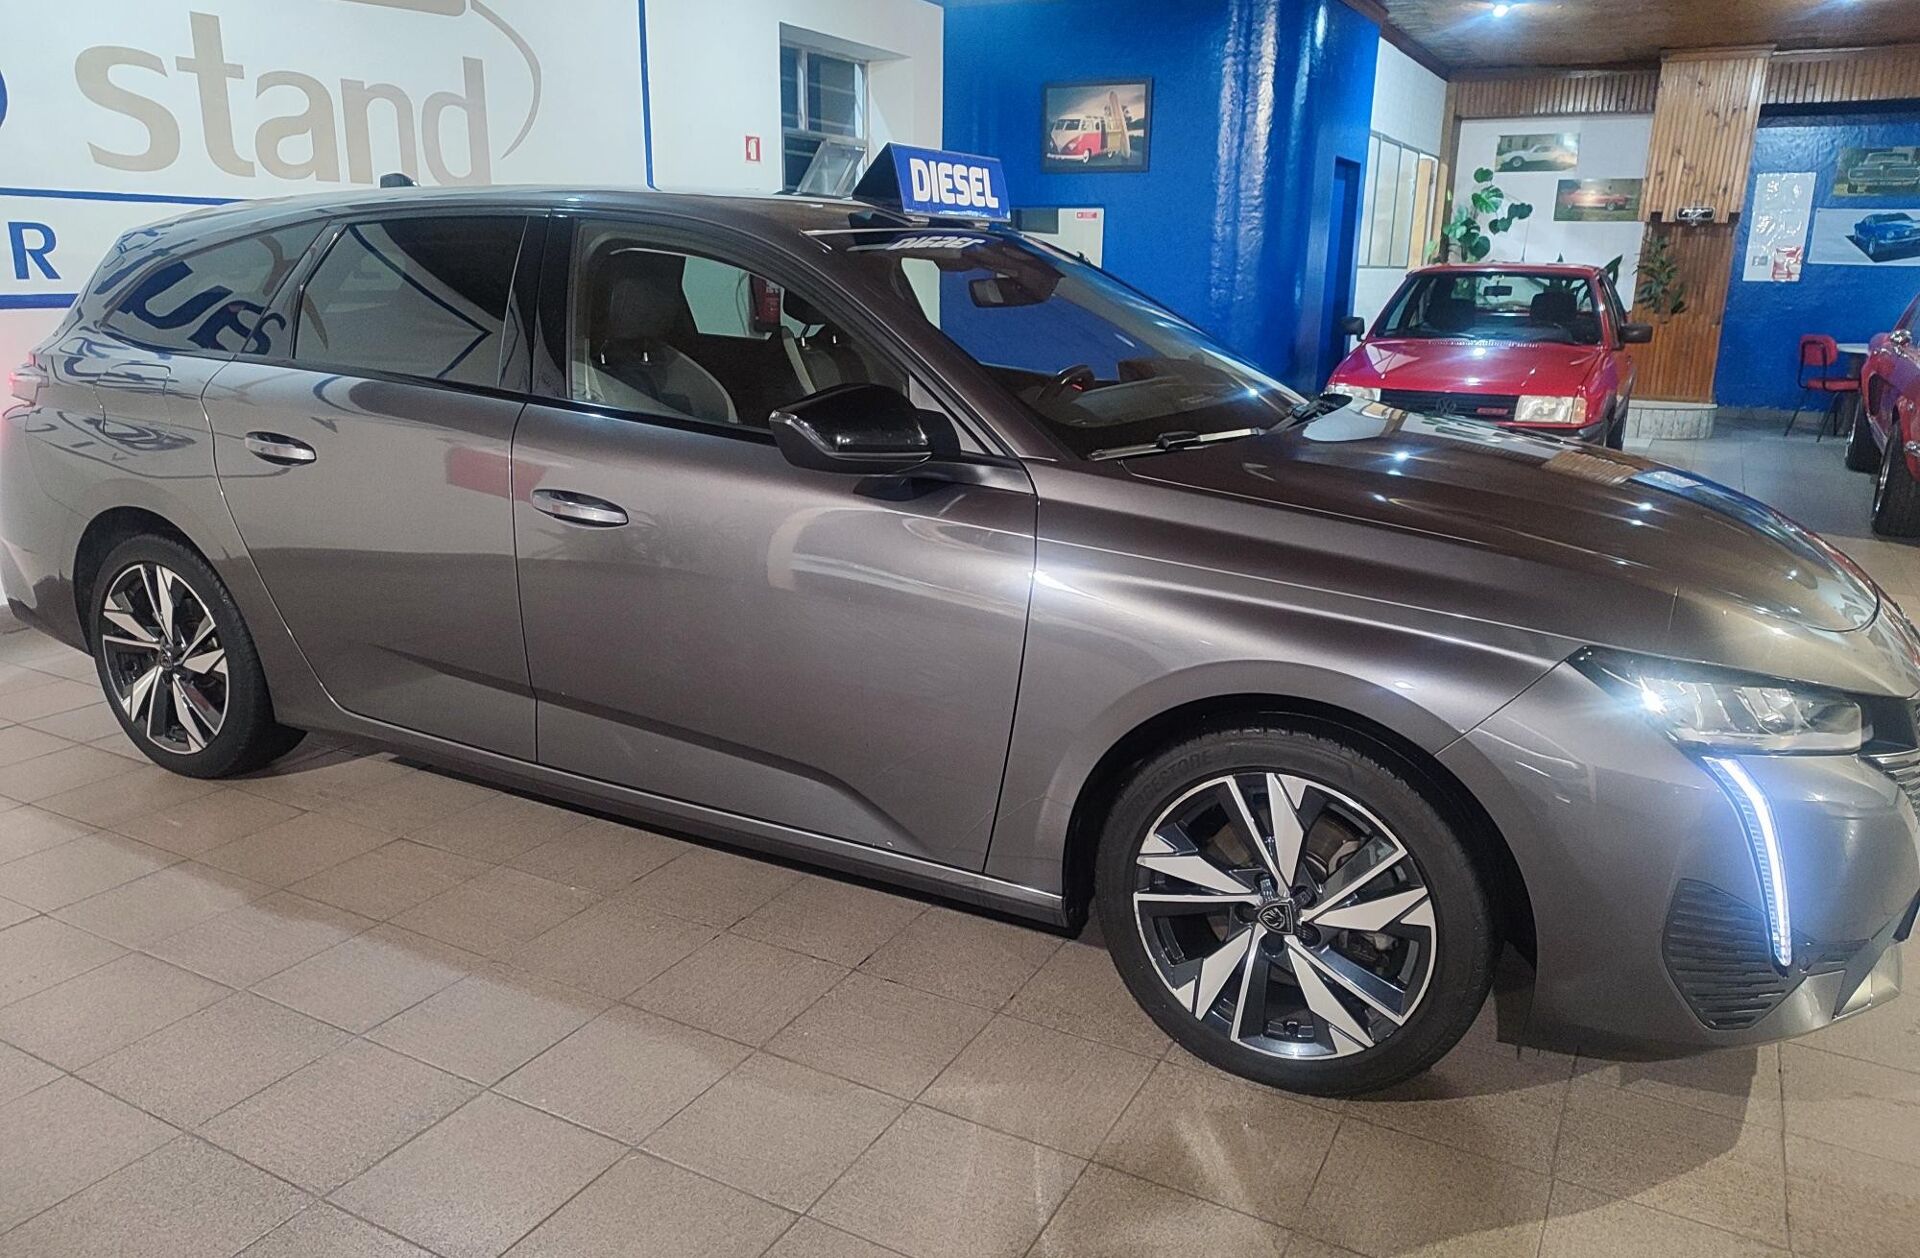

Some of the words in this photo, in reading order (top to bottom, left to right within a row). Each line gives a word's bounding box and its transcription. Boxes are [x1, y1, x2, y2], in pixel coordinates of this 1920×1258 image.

[74, 10, 492, 187] stand
[909, 157, 999, 209] DIESEL
[8, 221, 61, 280] R
